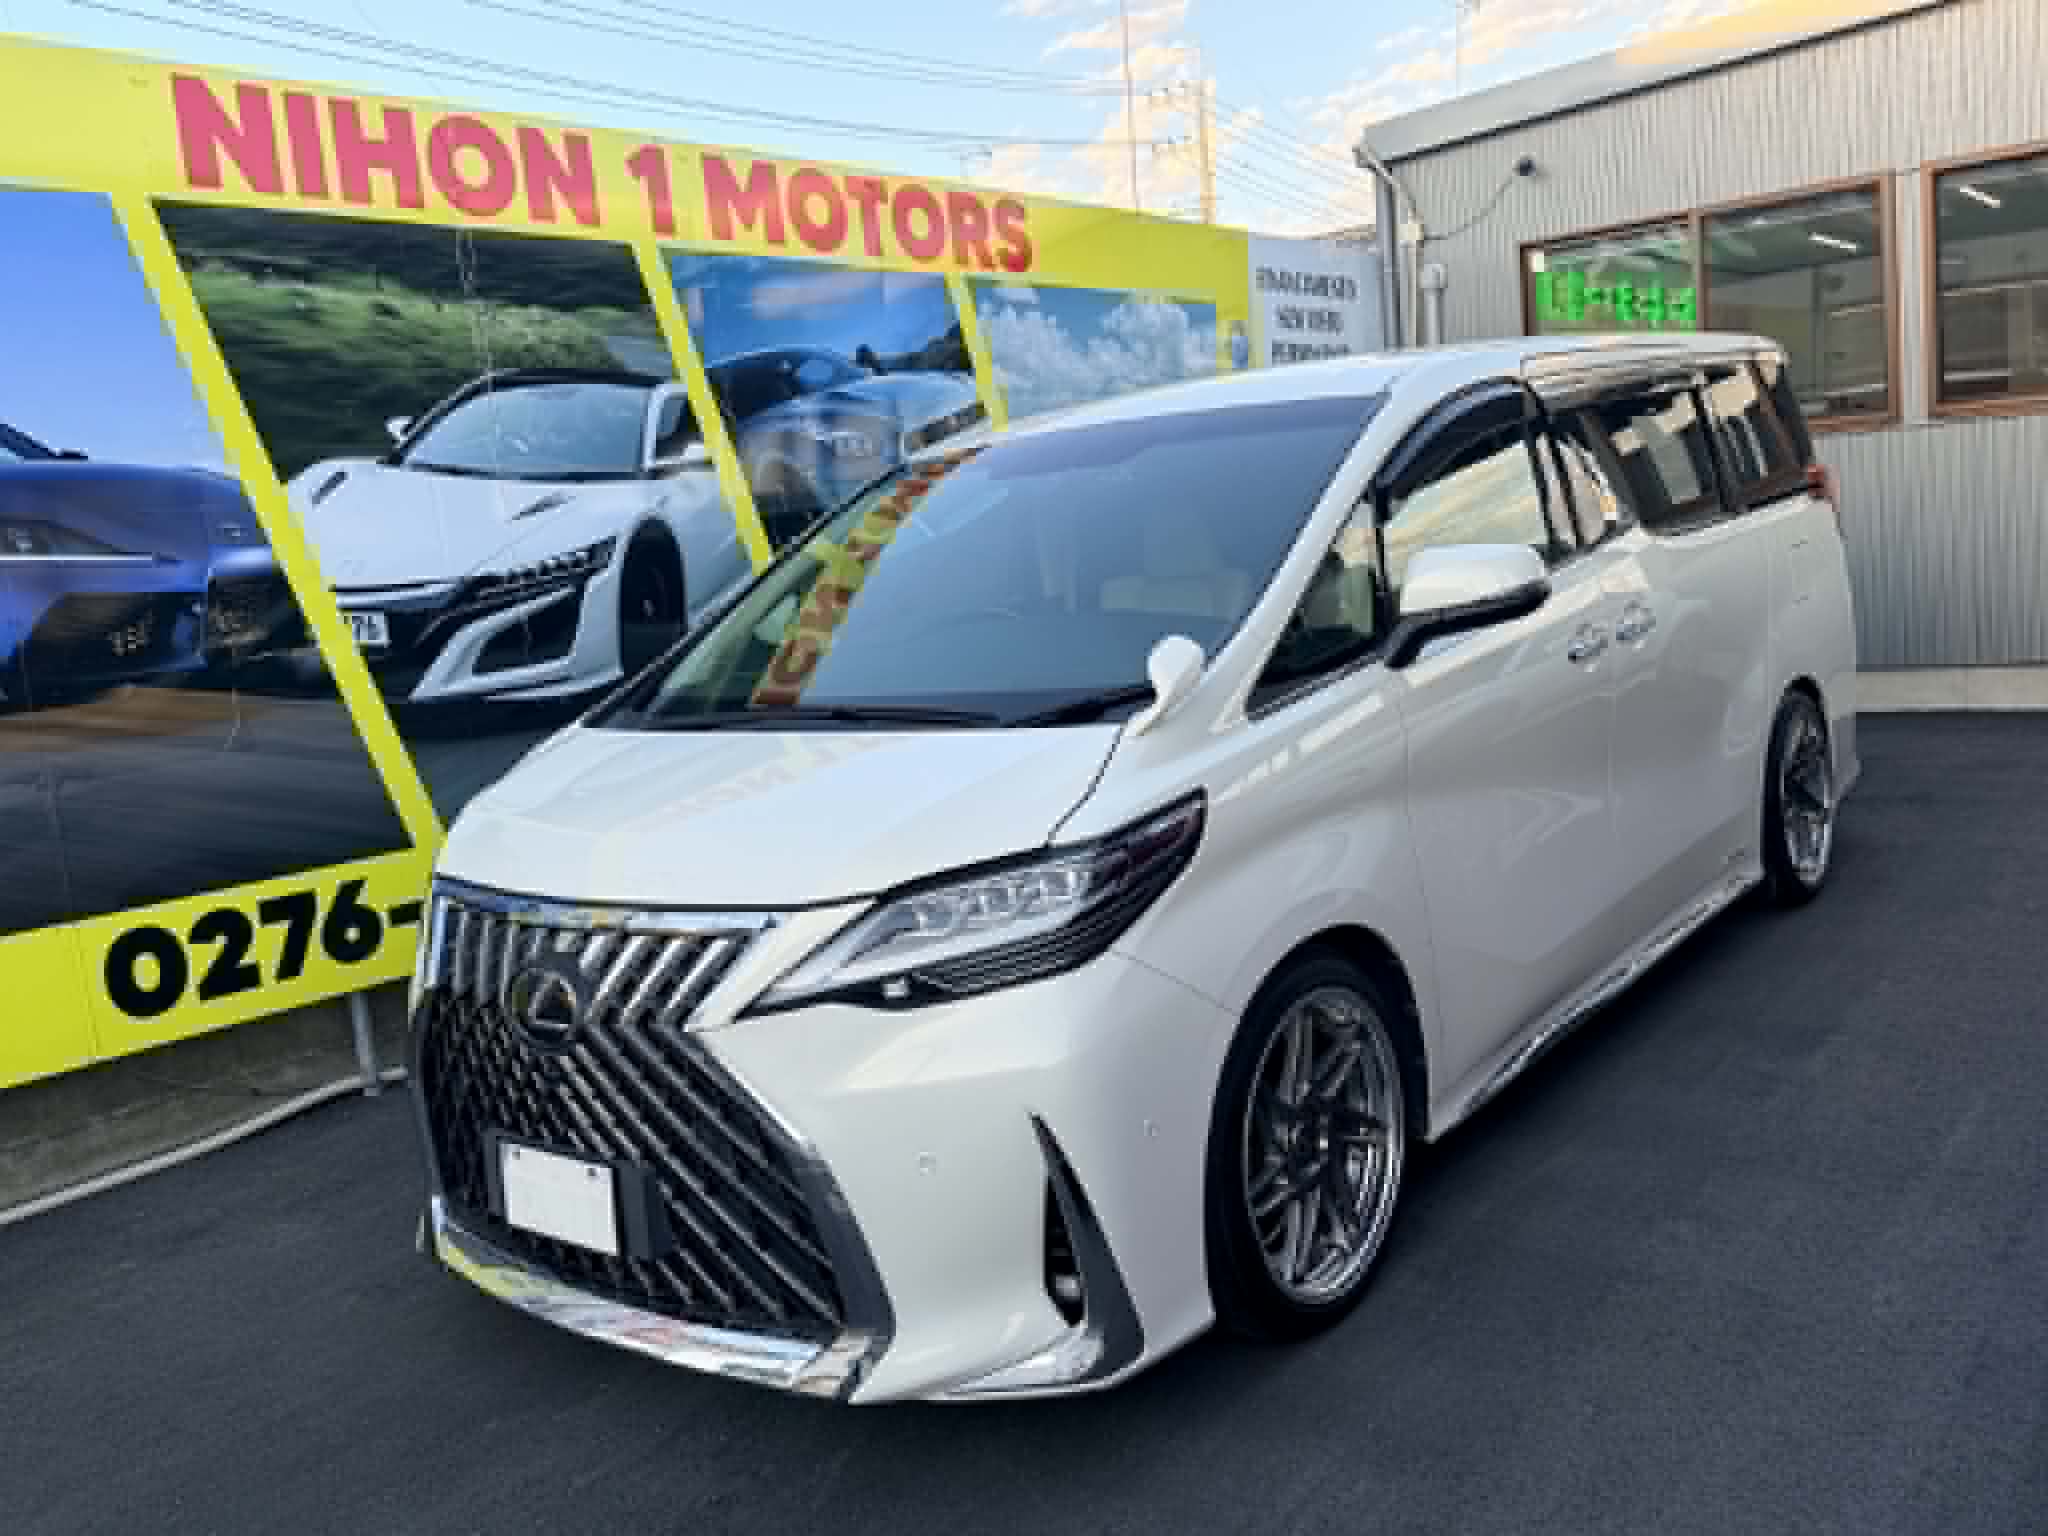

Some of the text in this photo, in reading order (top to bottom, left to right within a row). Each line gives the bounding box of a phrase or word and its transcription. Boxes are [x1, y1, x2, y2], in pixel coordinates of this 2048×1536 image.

[172, 73, 1034, 273] NIHON 1 MOTORS
